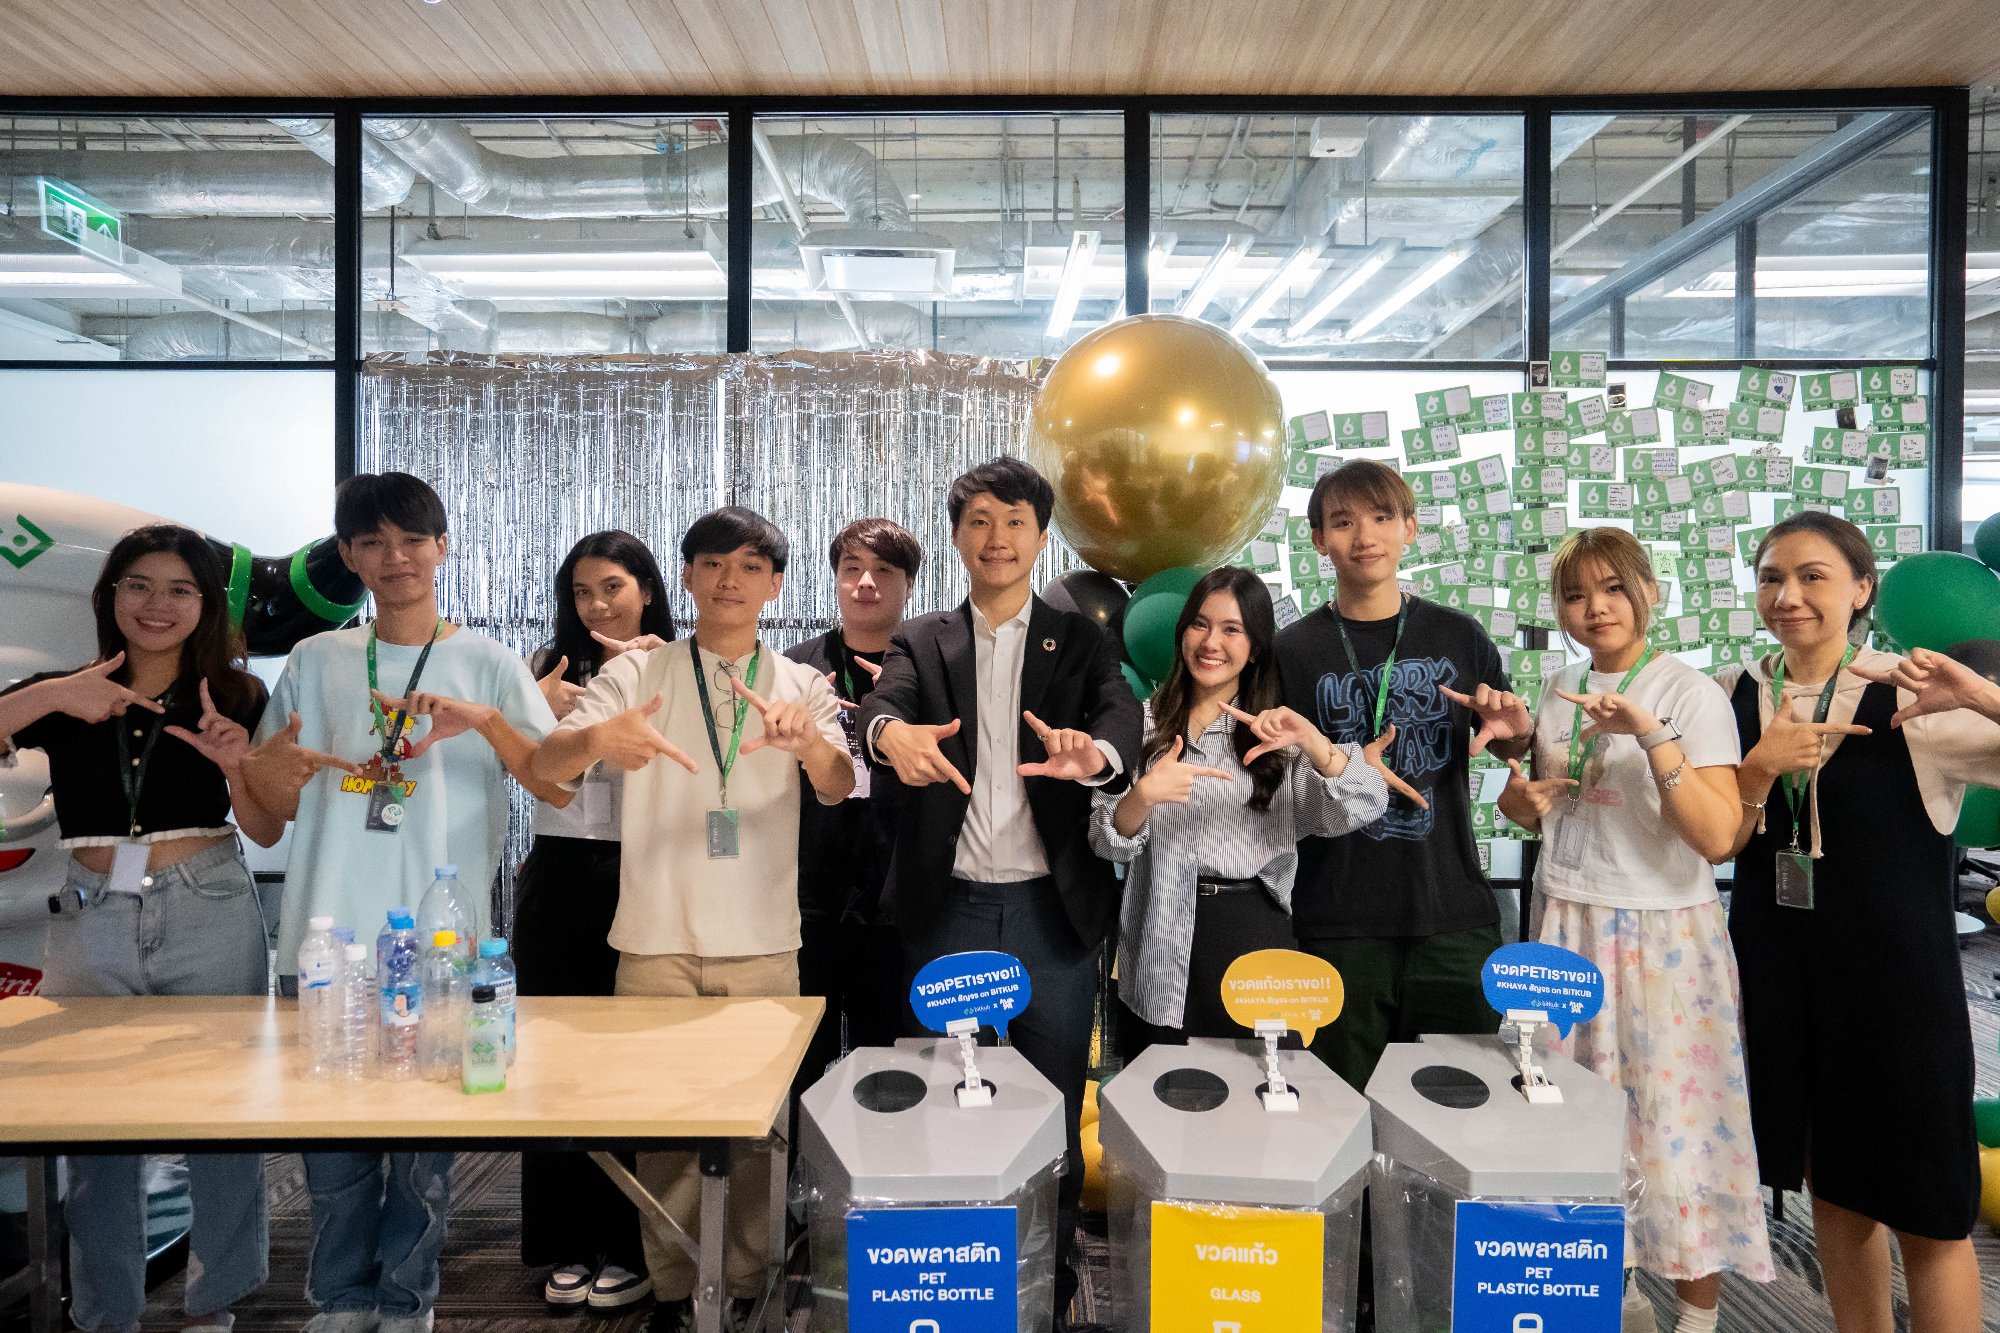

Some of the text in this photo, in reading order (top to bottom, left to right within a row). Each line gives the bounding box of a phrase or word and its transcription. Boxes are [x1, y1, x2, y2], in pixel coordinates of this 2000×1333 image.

[1560, 355, 1572, 374] 6
[1664, 379, 1677, 396] 6
[1748, 372, 1760, 390] 6
[1810, 378, 1822, 396] 6
[1870, 372, 1882, 390] 6
[1521, 396, 1533, 414] 6
[1682, 416, 1694, 433] 6
[1737, 408, 1750, 425] 6
[1524, 433, 1536, 451] 6
[1822, 432, 1834, 450] 6
[1693, 466, 1704, 484] 6
[1746, 460, 1758, 478] 6
[1521, 471, 1533, 488] 6
[1802, 472, 1813, 488] 6
[1588, 486, 1599, 504] 6
[1647, 484, 1658, 502] 6
[1854, 492, 1866, 510] 6
[1522, 513, 1534, 531] 6
[1688, 526, 1699, 545] 6
[1875, 529, 1886, 548] 6
[1516, 560, 1528, 577] 6
[1686, 560, 1698, 577] 6
[1517, 592, 1529, 609] 6
[1708, 612, 1720, 630] 6
[1520, 655, 1532, 672] 6
[926, 997, 956, 1008] #KHAYA
[990, 984, 1019, 996] BITKUB
[1496, 981, 1527, 990] #KHAYA
[1562, 988, 1592, 997] BITKUB
[866, 1242, 1001, 1264] ขวดพลาสติก
[1195, 1242, 1278, 1265] ขวดแก้ว
[1475, 1239, 1608, 1260] ขวดพลาสติก
[919, 1272, 946, 1284] PET
[1525, 1267, 1553, 1279] PET
[872, 1288, 994, 1302] PLASTIC BOTTLE
[1210, 1288, 1261, 1303] GLASS
[1478, 1282, 1600, 1297] PLASTIC BOTTLE
